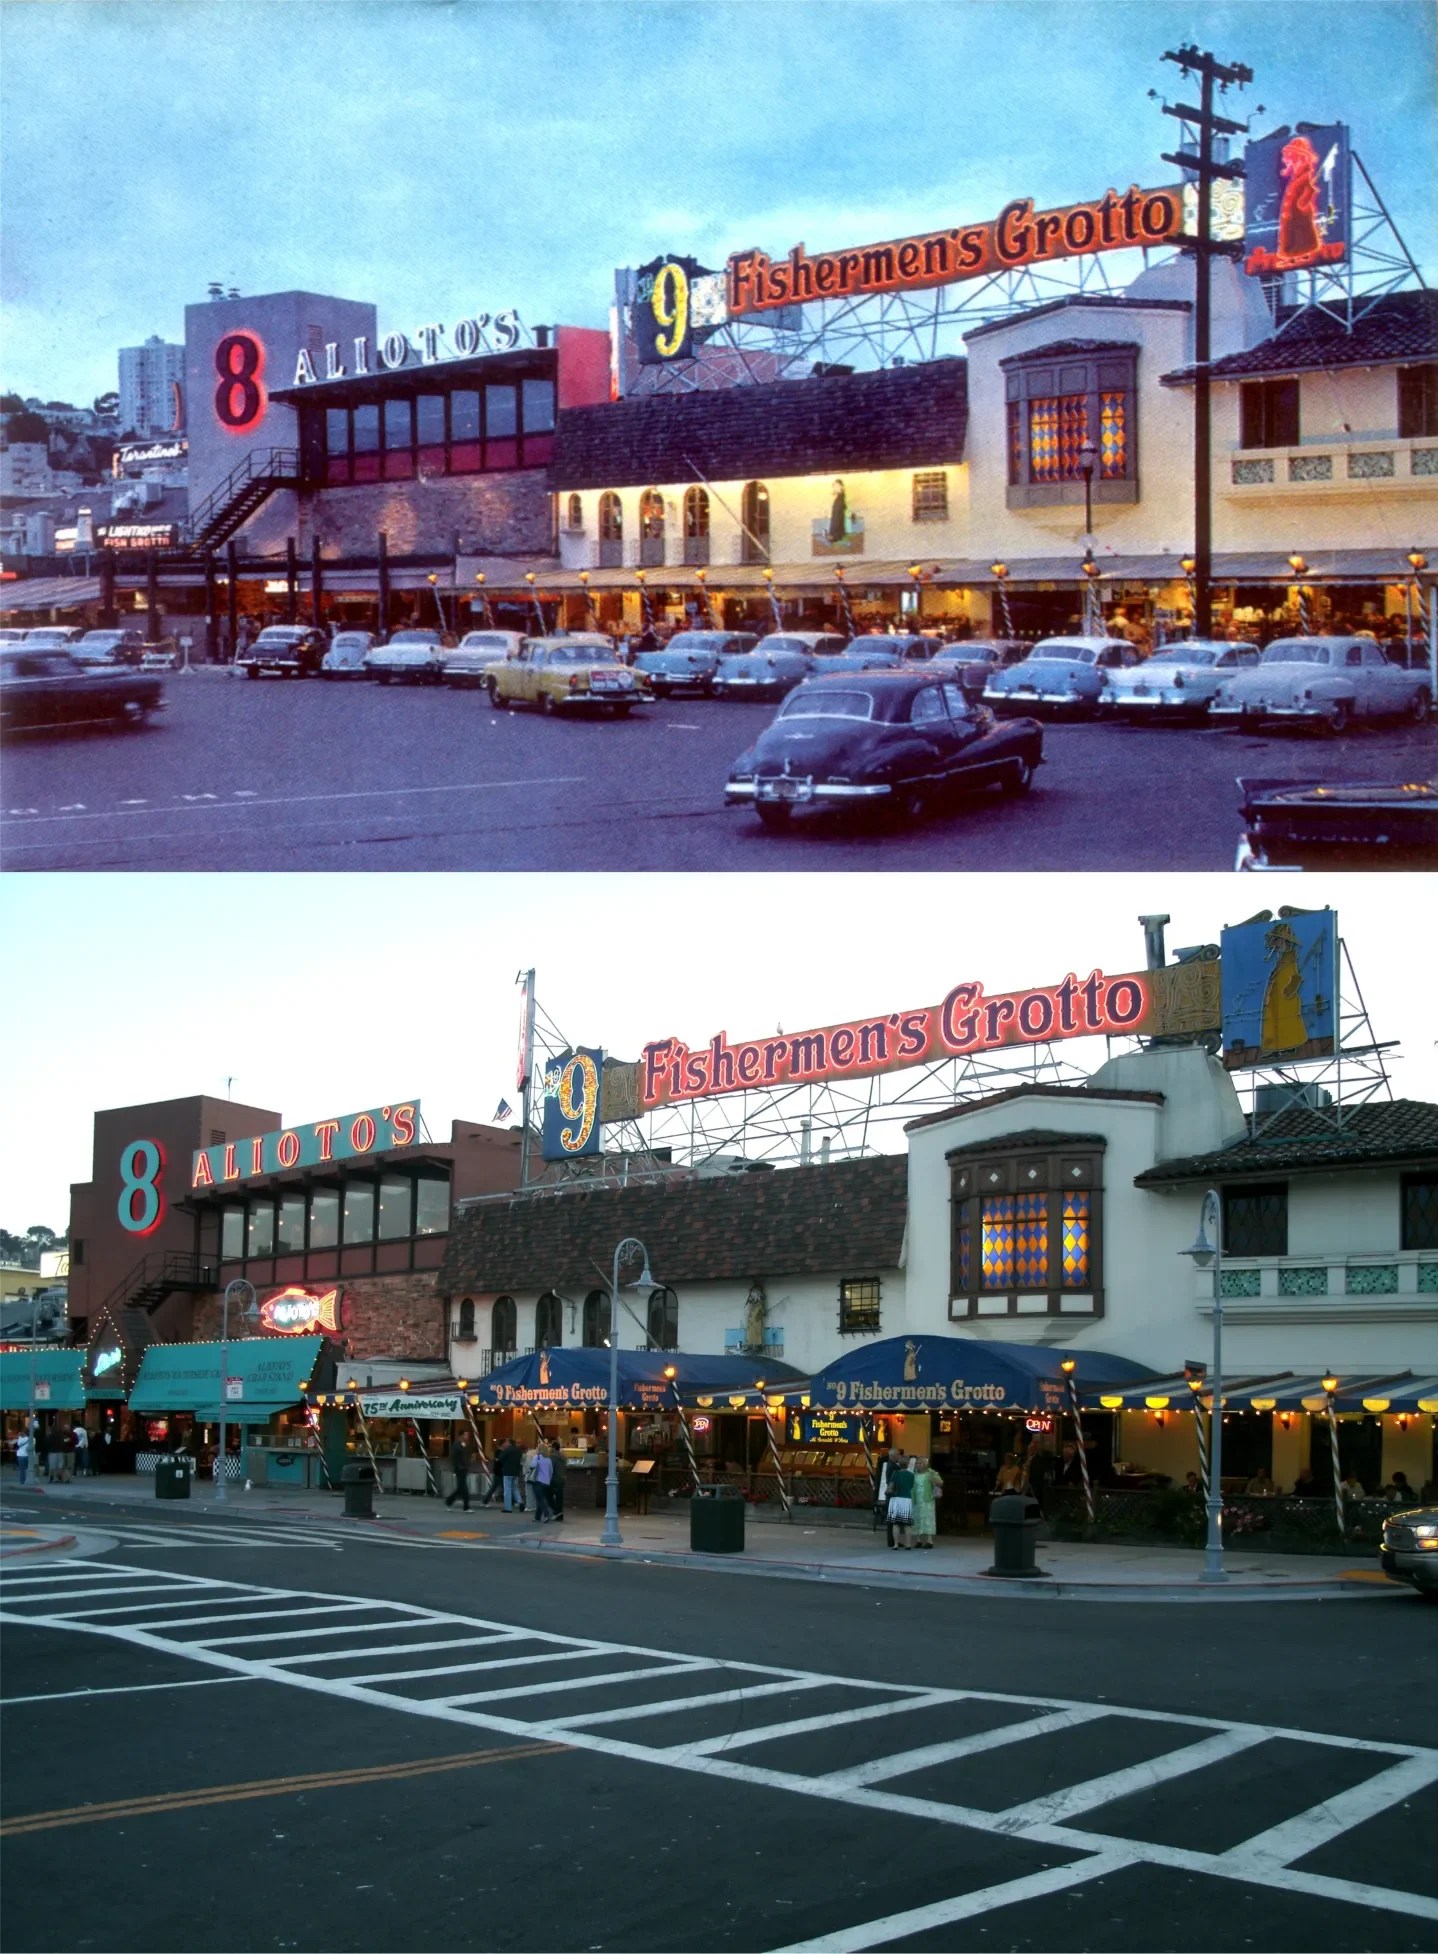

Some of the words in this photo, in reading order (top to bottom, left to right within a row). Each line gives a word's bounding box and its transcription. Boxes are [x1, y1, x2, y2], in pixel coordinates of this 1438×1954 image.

[729, 227, 985, 310] Fishermen's
[996, 185, 1174, 263] Grotto
[293, 309, 519, 385] ALIOTO'S
[652, 263, 689, 356] 9
[214, 334, 262, 427] 8
[642, 1007, 930, 1103] Fishermen's
[940, 969, 1150, 1049] Grotto
[192, 1104, 416, 1188] ALIOTO'S
[559, 1054, 599, 1152] 9
[117, 1139, 163, 1233] 8
[497, 1385, 504, 1399] 9
[505, 1384, 569, 1400] Fishermen's
[572, 1382, 608, 1400] Grotto
[836, 1382, 847, 1401] 9
[850, 1379, 947, 1401] Fishermen's
[951, 1378, 1006, 1401] Grotto
